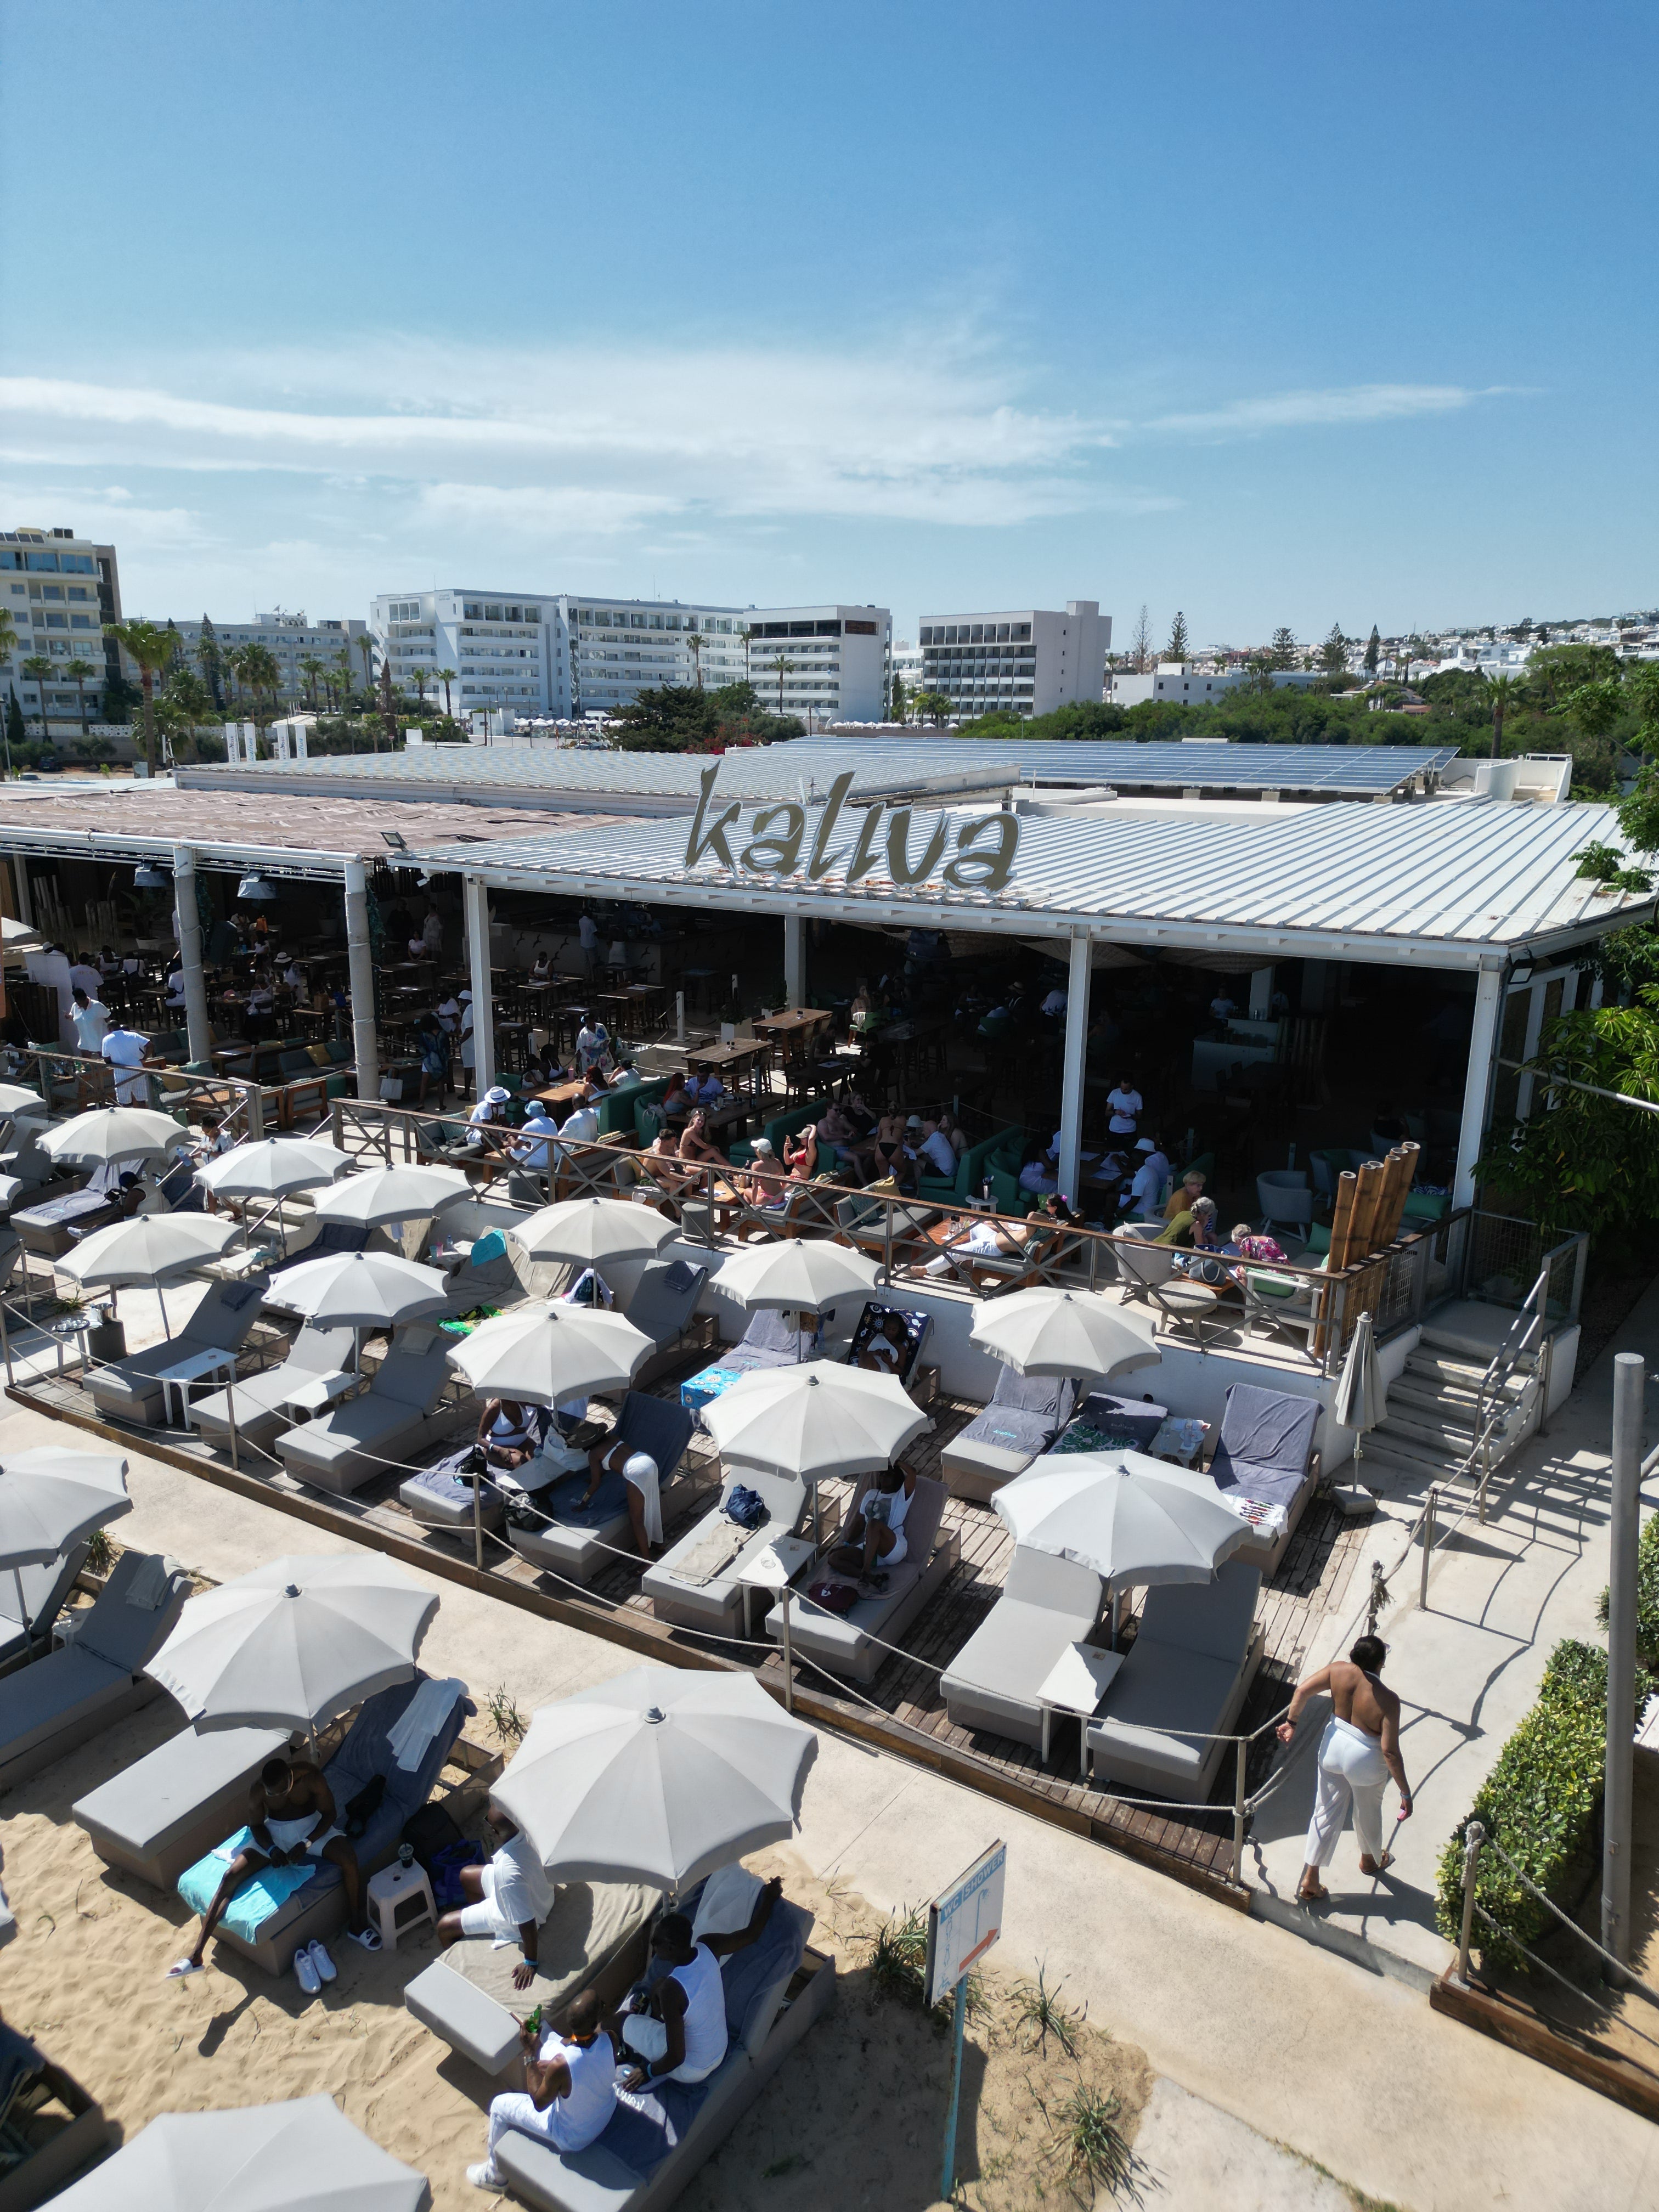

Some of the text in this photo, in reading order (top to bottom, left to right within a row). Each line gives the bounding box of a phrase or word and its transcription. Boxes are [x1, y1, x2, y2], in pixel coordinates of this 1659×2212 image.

[684, 758, 1021, 894] kaliva
[944, 1851, 1003, 1917] WC SHOWER
